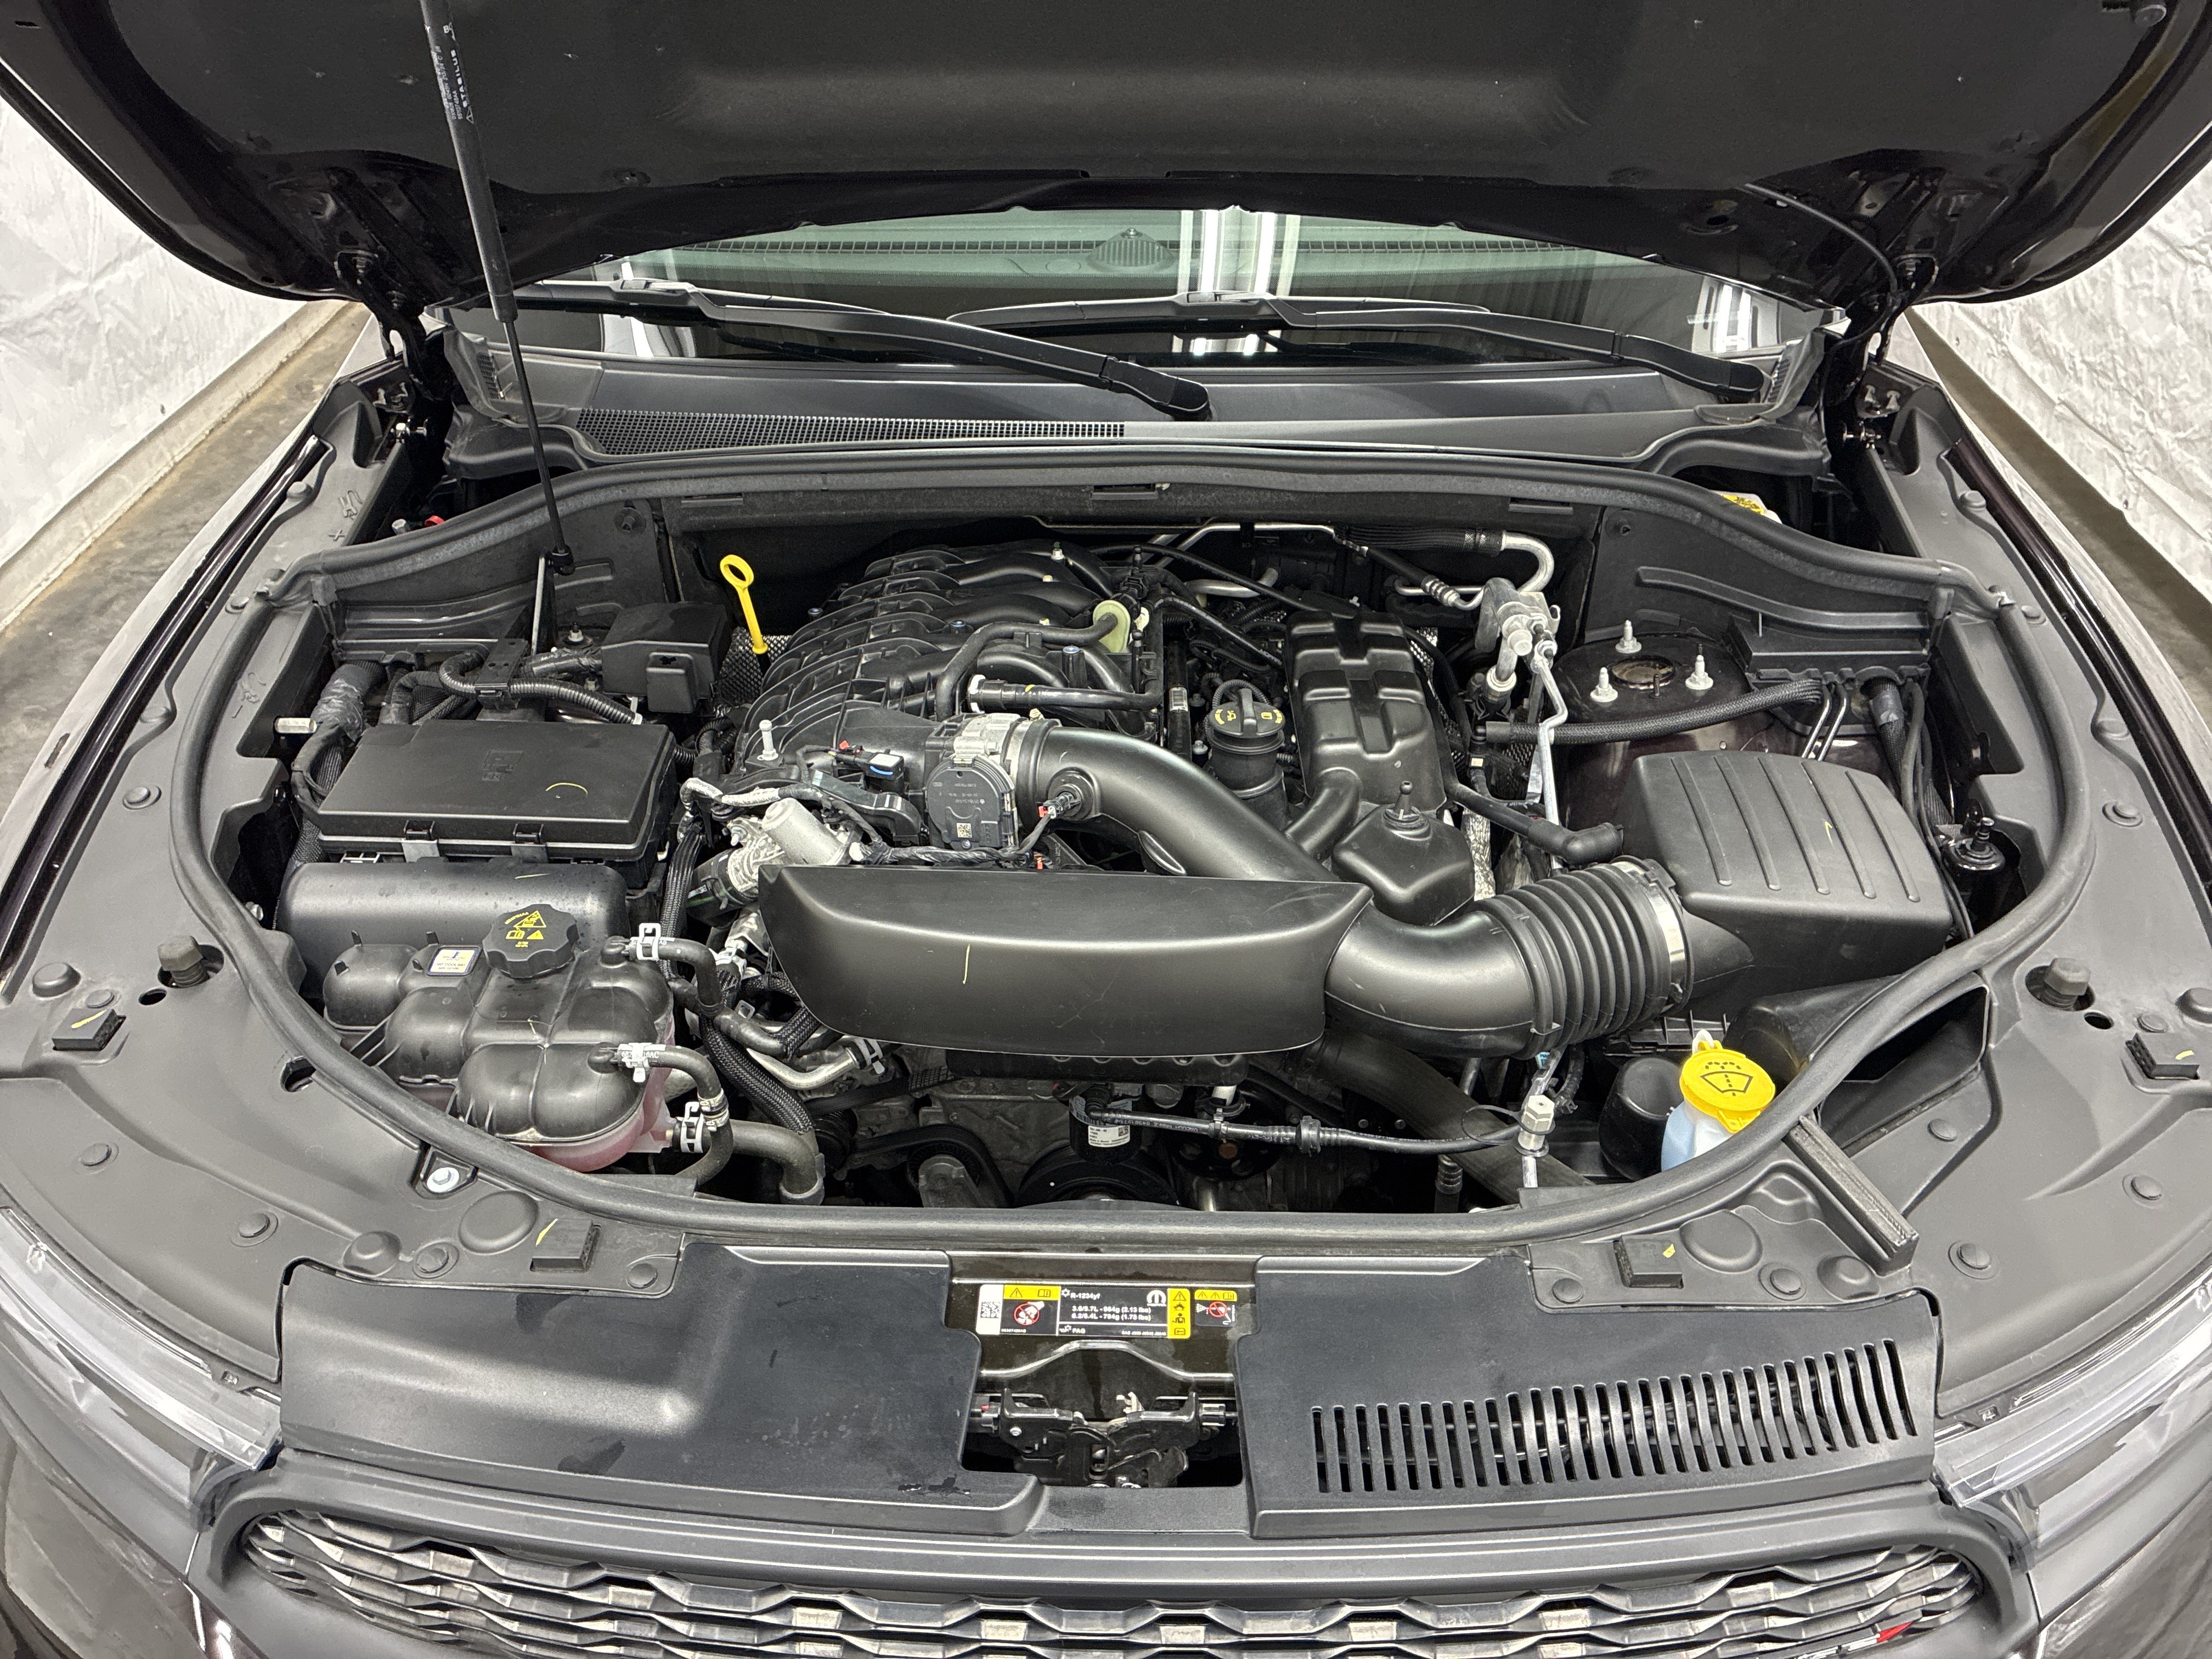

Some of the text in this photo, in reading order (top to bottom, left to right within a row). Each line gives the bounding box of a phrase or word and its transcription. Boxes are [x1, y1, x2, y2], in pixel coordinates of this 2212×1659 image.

[450, 49, 467, 108] STABILUS
[621, 1051, 660, 1059] 68216AC
[1070, 1292, 1101, 1300] R-1234yf
